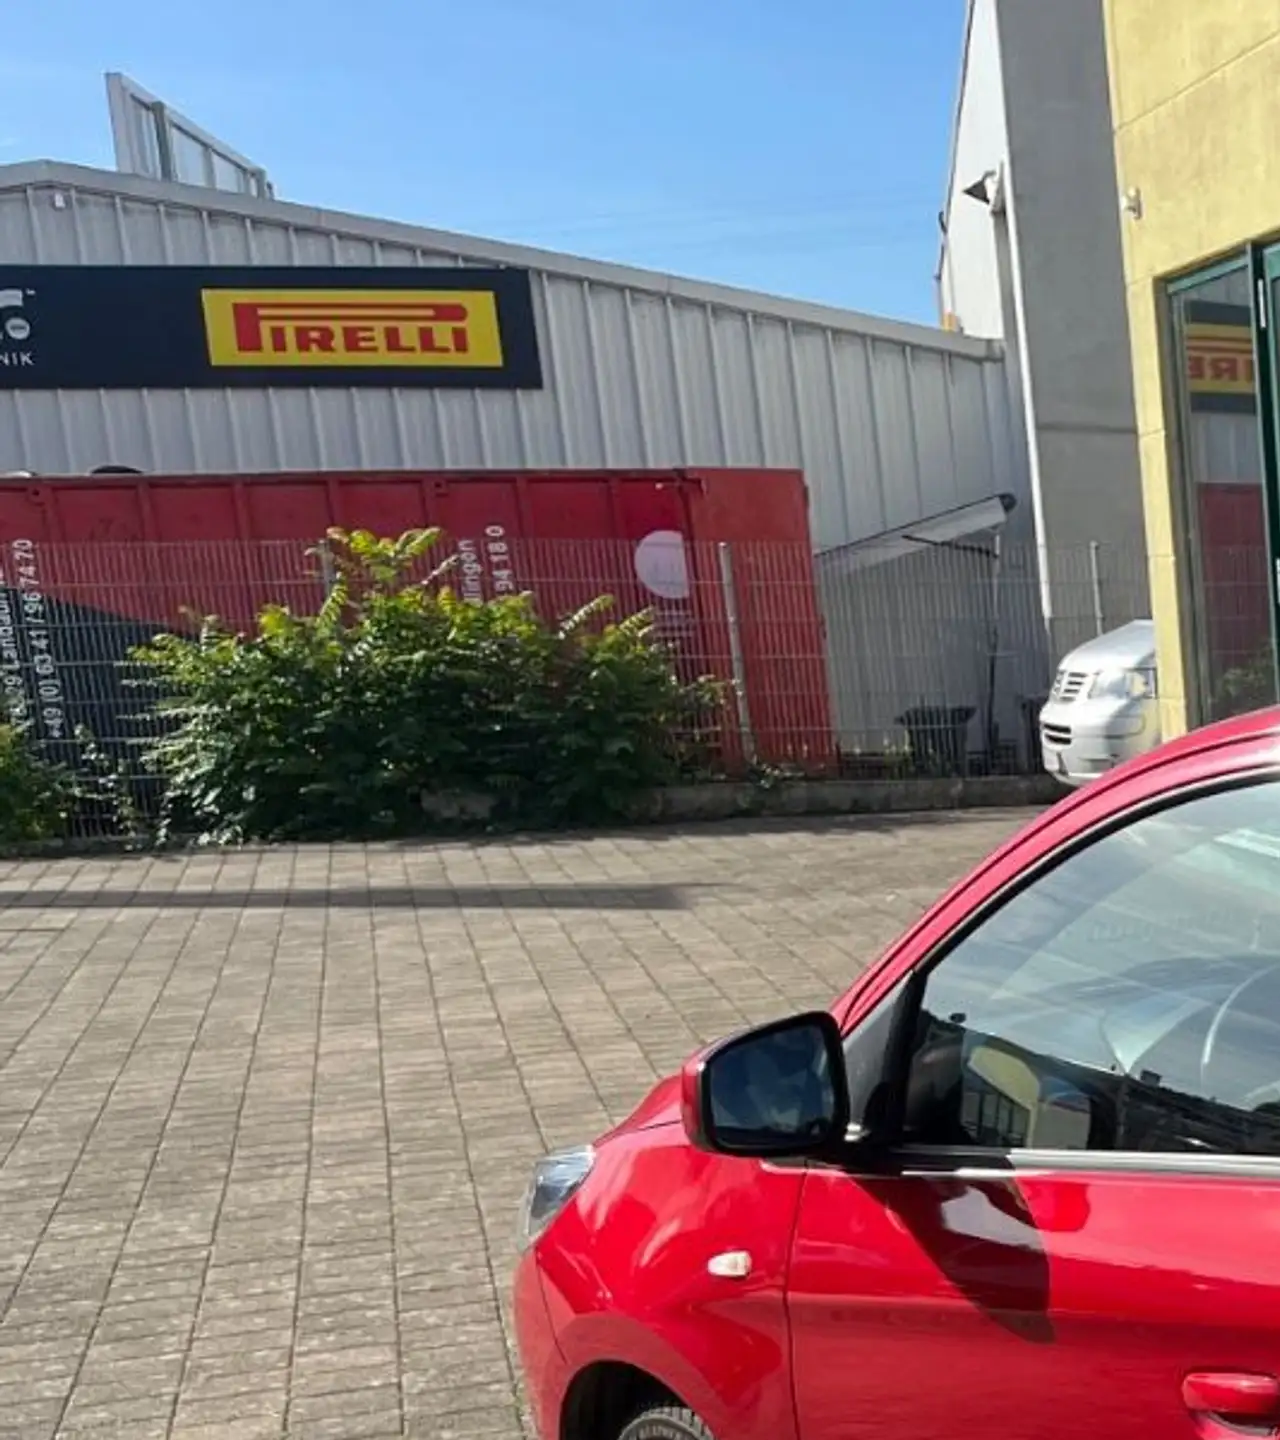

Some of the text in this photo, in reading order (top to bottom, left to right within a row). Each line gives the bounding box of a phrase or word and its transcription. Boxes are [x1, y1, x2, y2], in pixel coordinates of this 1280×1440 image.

[231, 302, 468, 353] PIRELLI
[12, 539, 34, 560] 70
[18, 566, 40, 588] 74
[22, 591, 43, 613] 96
[29, 629, 48, 649] 41
[34, 653, 54, 675] 63
